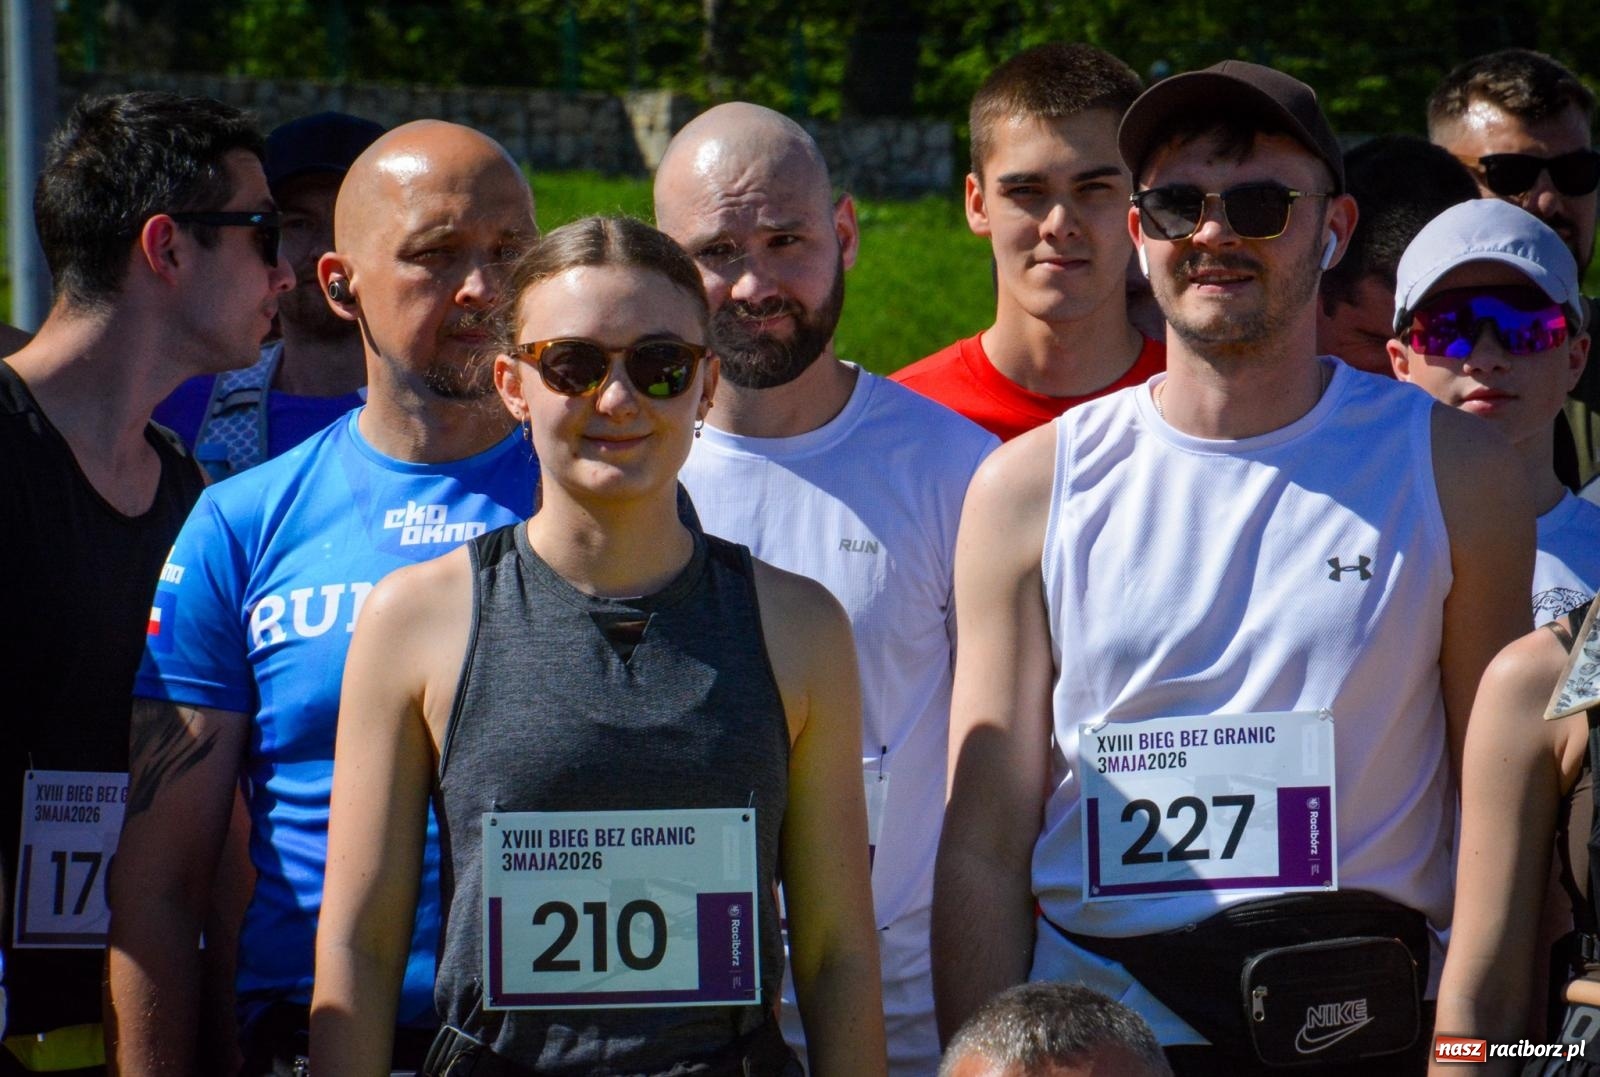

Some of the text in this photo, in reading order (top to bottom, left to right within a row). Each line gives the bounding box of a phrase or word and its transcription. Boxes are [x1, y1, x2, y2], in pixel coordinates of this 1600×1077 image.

[839, 538, 879, 554] RUN
[1097, 726, 1276, 753] XVIII BIEG BEZ GRANIC
[1097, 751, 1188, 774] 3MAJA2026
[36, 784, 64, 801] XVIII
[66, 785, 94, 803] BIEG
[96, 786, 118, 803] BEZ
[34, 805, 101, 823] 3MAJA2026
[501, 826, 696, 849] XVIII BIEG BEZ GRANIC
[1120, 794, 1256, 866] 227
[1310, 811, 1320, 855] Racibórz
[501, 851, 603, 872] 3MAJA2026
[51, 850, 116, 915] 17
[532, 899, 668, 973] 210
[731, 919, 742, 966] Racibórz
[1306, 998, 1368, 1029] NIKE
